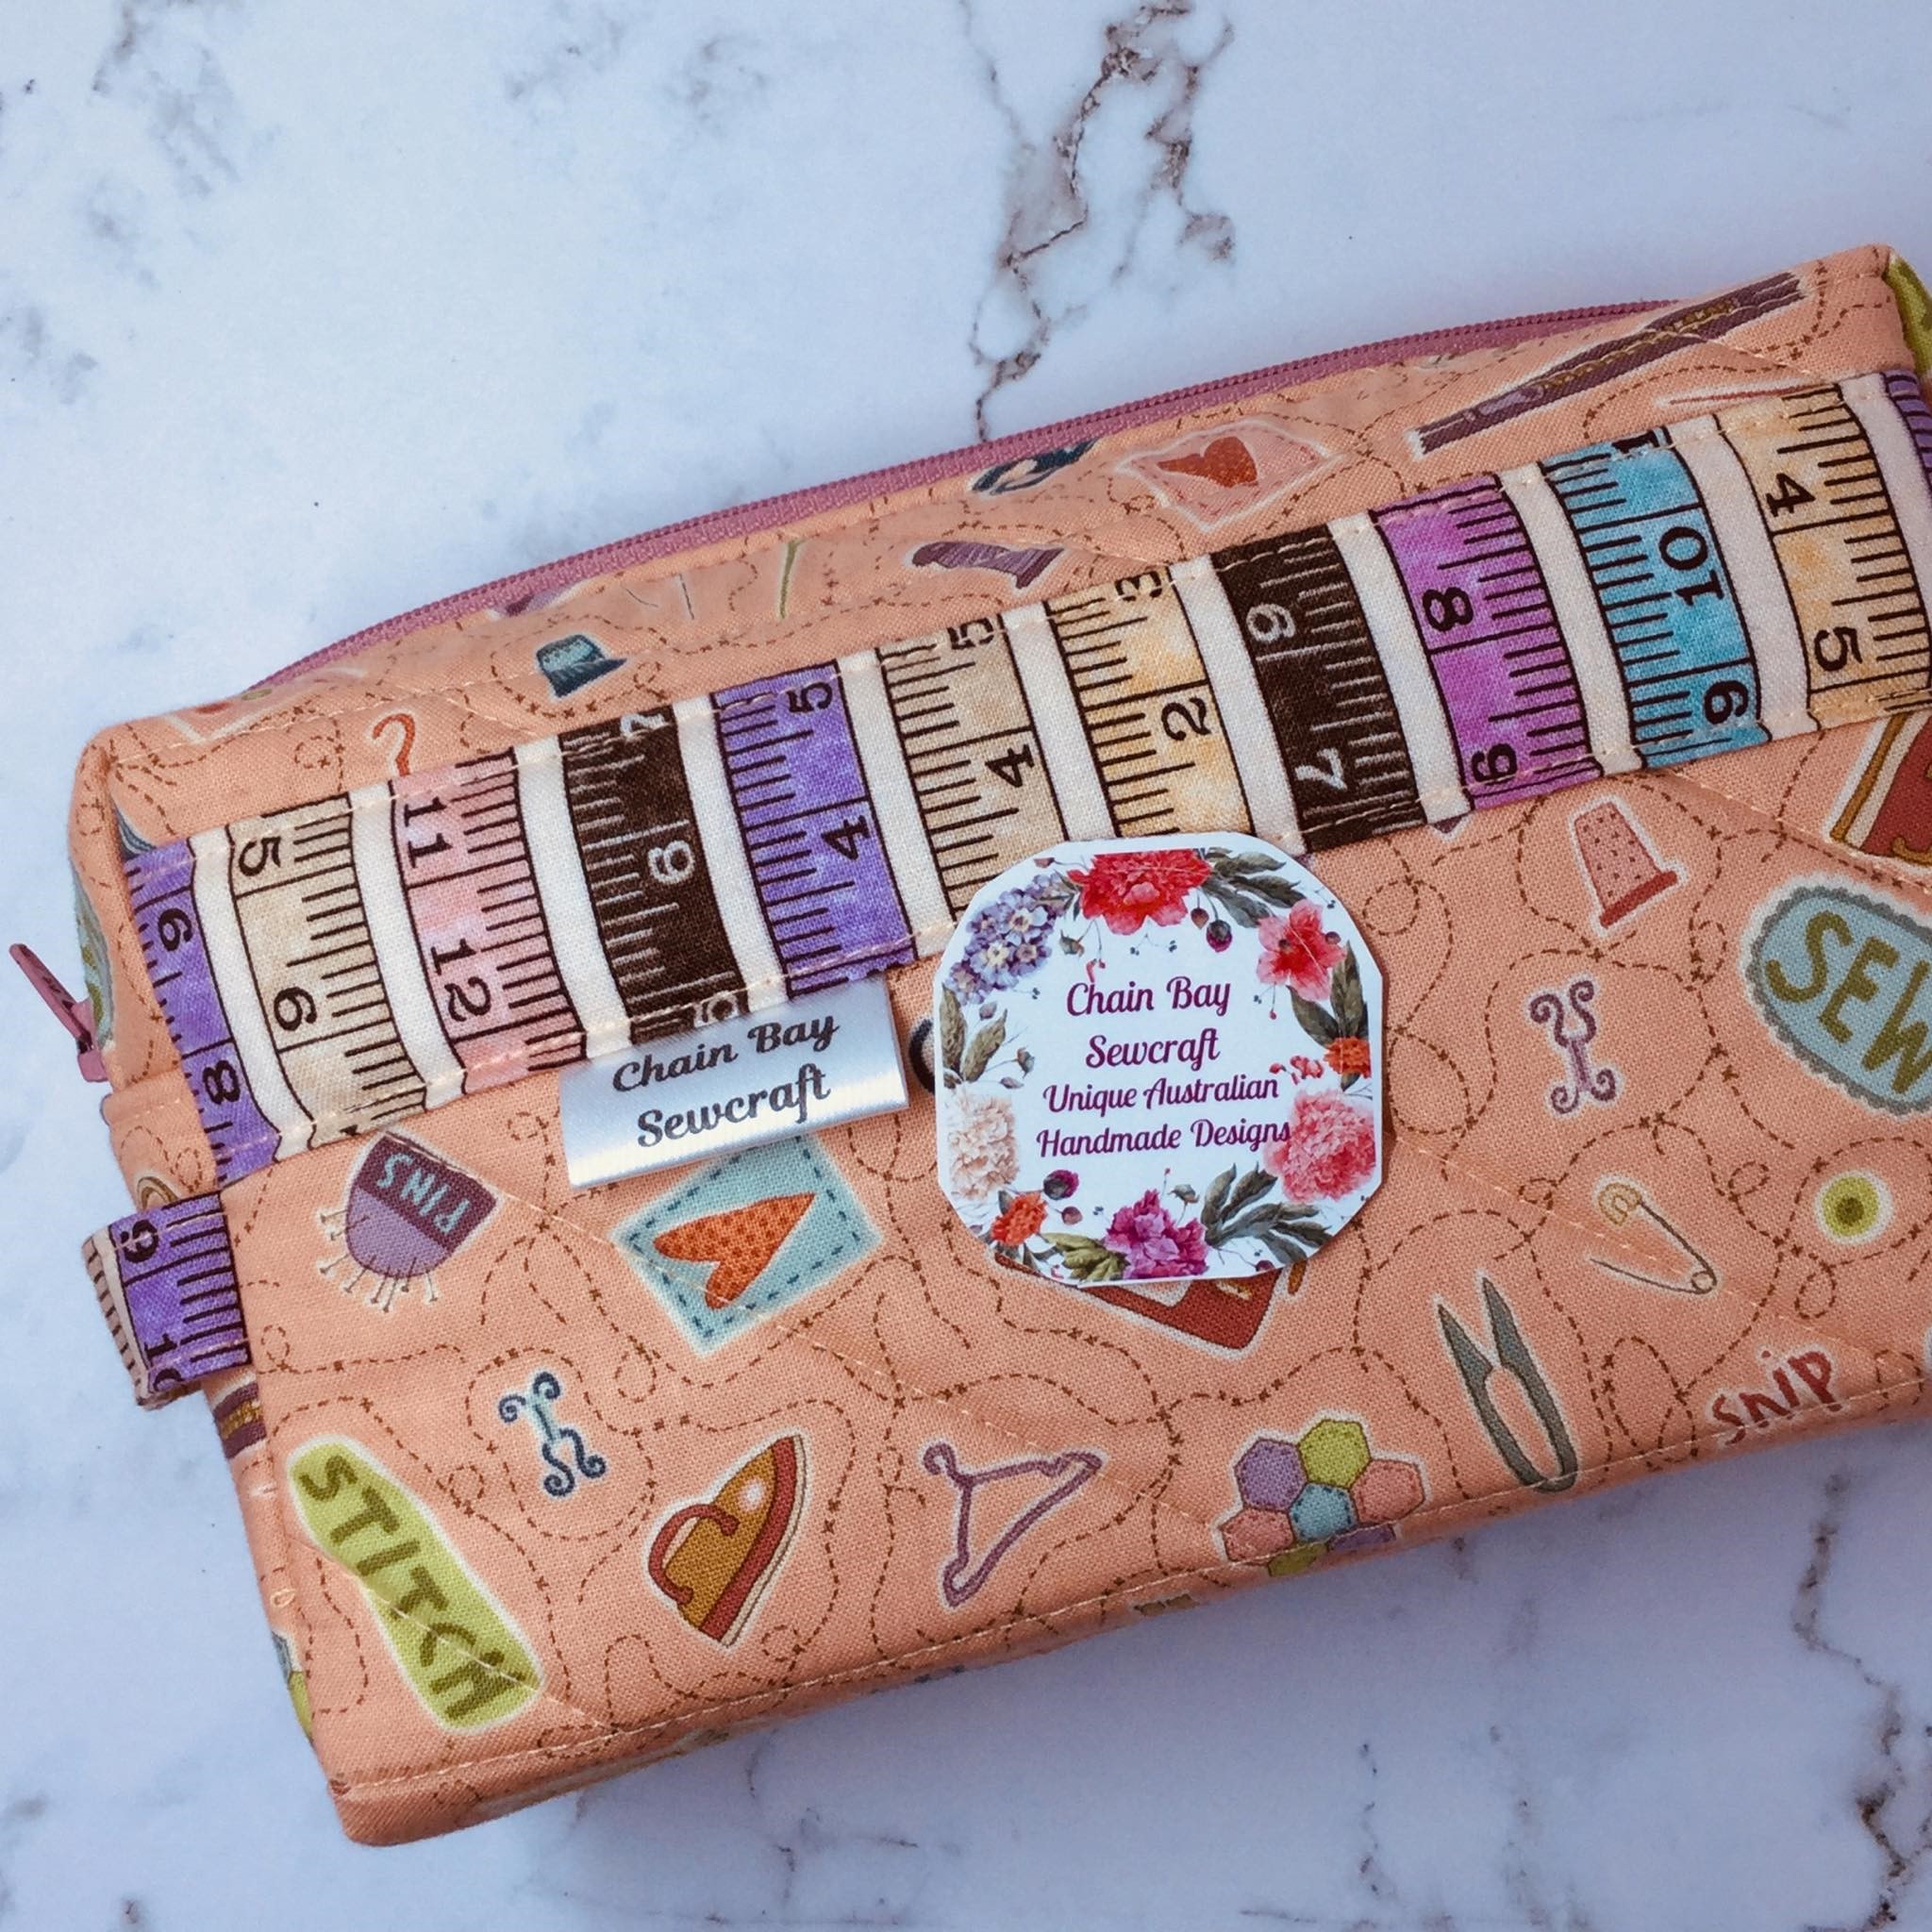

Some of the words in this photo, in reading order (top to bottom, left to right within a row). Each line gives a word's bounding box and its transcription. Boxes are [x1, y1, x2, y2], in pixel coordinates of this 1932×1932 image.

[1766, 473, 1816, 516] 4
[1658, 526, 1725, 606] 10
[1423, 587, 1474, 631] 8
[1813, 627, 1863, 671] 5
[789, 681, 834, 712] 5
[1161, 696, 1211, 741] 2
[985, 743, 1036, 788] 4
[1295, 750, 1347, 791] 7
[404, 796, 450, 867] 11
[822, 815, 873, 860] 4
[239, 836, 285, 876] 5
[431, 938, 492, 1022] 12
[1067, 981, 1154, 1016] Chain
[1166, 975, 1232, 1018] Bay
[1764, 909, 1932, 1094] SEW
[612, 1039, 739, 1092] Chain
[748, 1012, 841, 1058] Bay
[1085, 1028, 1221, 1072] Sewcraft
[203, 1062, 239, 1103] 8
[1042, 1083, 1138, 1118] Unique
[1143, 1075, 1279, 1109] Australian
[637, 1063, 832, 1148] Sewcraft
[1036, 1123, 1182, 1158] Handmade
[1191, 1118, 1291, 1154] Designs
[377, 1152, 470, 1234] PINS
[299, 1455, 528, 1719] STITCH
